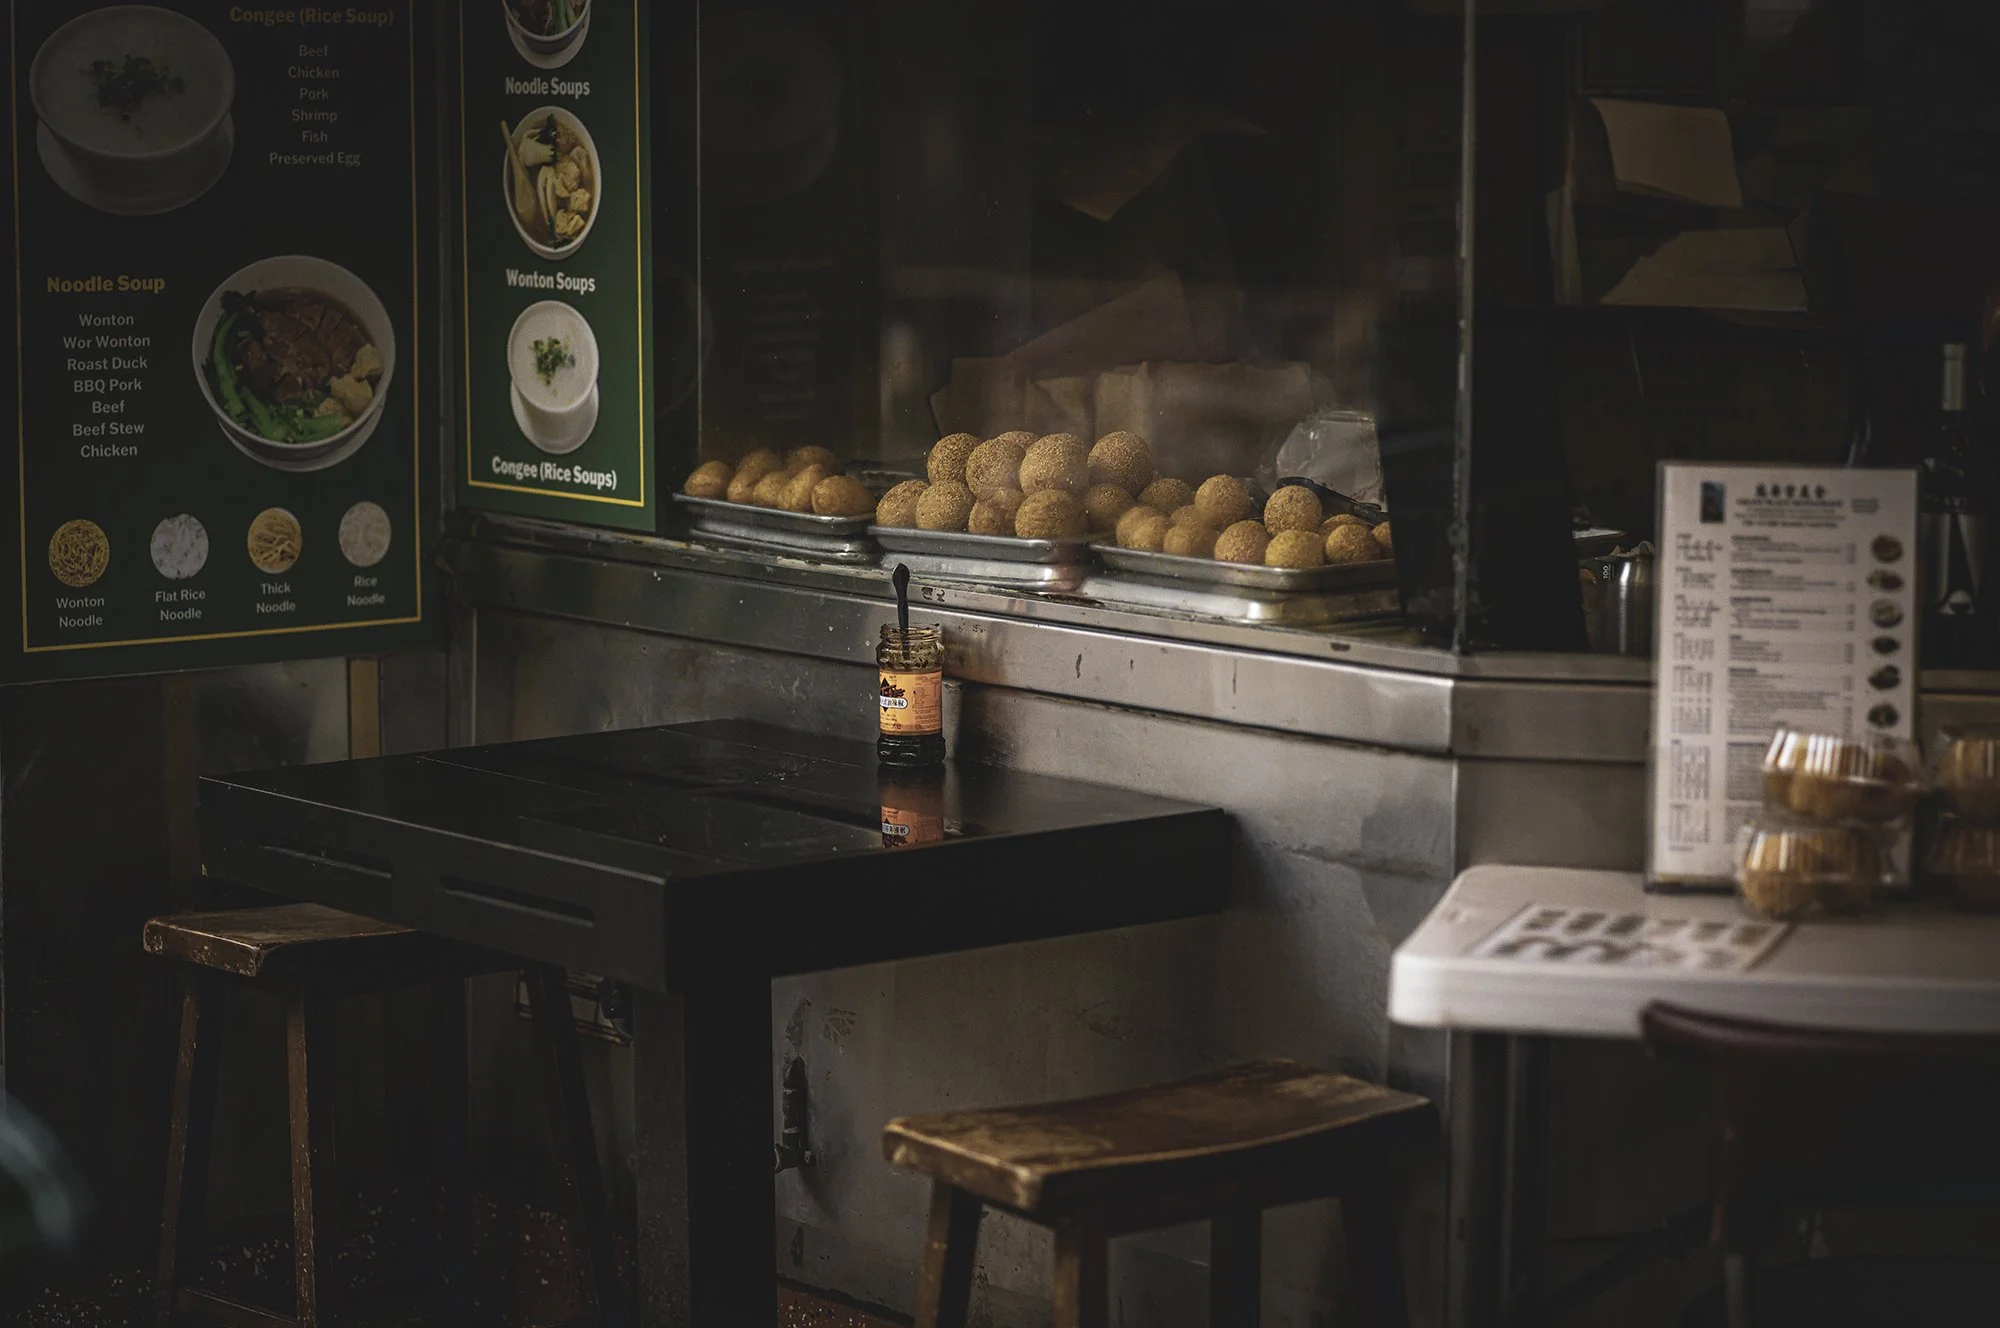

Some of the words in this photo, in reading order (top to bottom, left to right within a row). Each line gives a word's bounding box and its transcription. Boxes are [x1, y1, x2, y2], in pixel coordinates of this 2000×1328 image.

[229, 6, 296, 27] Congee
[299, 7, 342, 27] (Rice
[345, 7, 394, 28] Soup)
[298, 44, 328, 57] Beef
[287, 65, 340, 79] Chicken
[299, 87, 329, 101] Pork
[505, 77, 549, 95] Noodle
[550, 79, 591, 100] Soups
[291, 108, 338, 124] Shrimp
[302, 129, 328, 143] Fish
[269, 151, 334, 165] Preserved
[337, 152, 361, 167] Egg
[47, 275, 114, 293] Noodle
[117, 274, 166, 294] Soup
[506, 269, 555, 289] Wonton
[556, 271, 596, 296] Soups
[78, 313, 134, 327] Wonton
[63, 336, 93, 349] Wor
[95, 335, 151, 348] Wonton
[67, 357, 109, 371] Roast
[111, 355, 148, 370] Duck
[73, 378, 106, 394] BBQ
[109, 377, 143, 392] Pork
[92, 400, 125, 414] Beef
[72, 422, 106, 437] Beef
[109, 421, 145, 435] Stew
[80, 443, 138, 458] Chicken
[491, 456, 538, 480] Congee
[539, 463, 572, 482] (Rice
[573, 465, 618, 491] Soups)
[260, 581, 291, 595] Thick
[353, 575, 378, 587] Rice
[155, 591, 178, 603] Flat
[180, 588, 206, 601] Rice
[347, 592, 385, 606] Noodle
[55, 597, 105, 609] Wonton
[256, 600, 296, 614] Noodle
[59, 614, 103, 628] Noodle
[160, 607, 202, 621] Noodle
